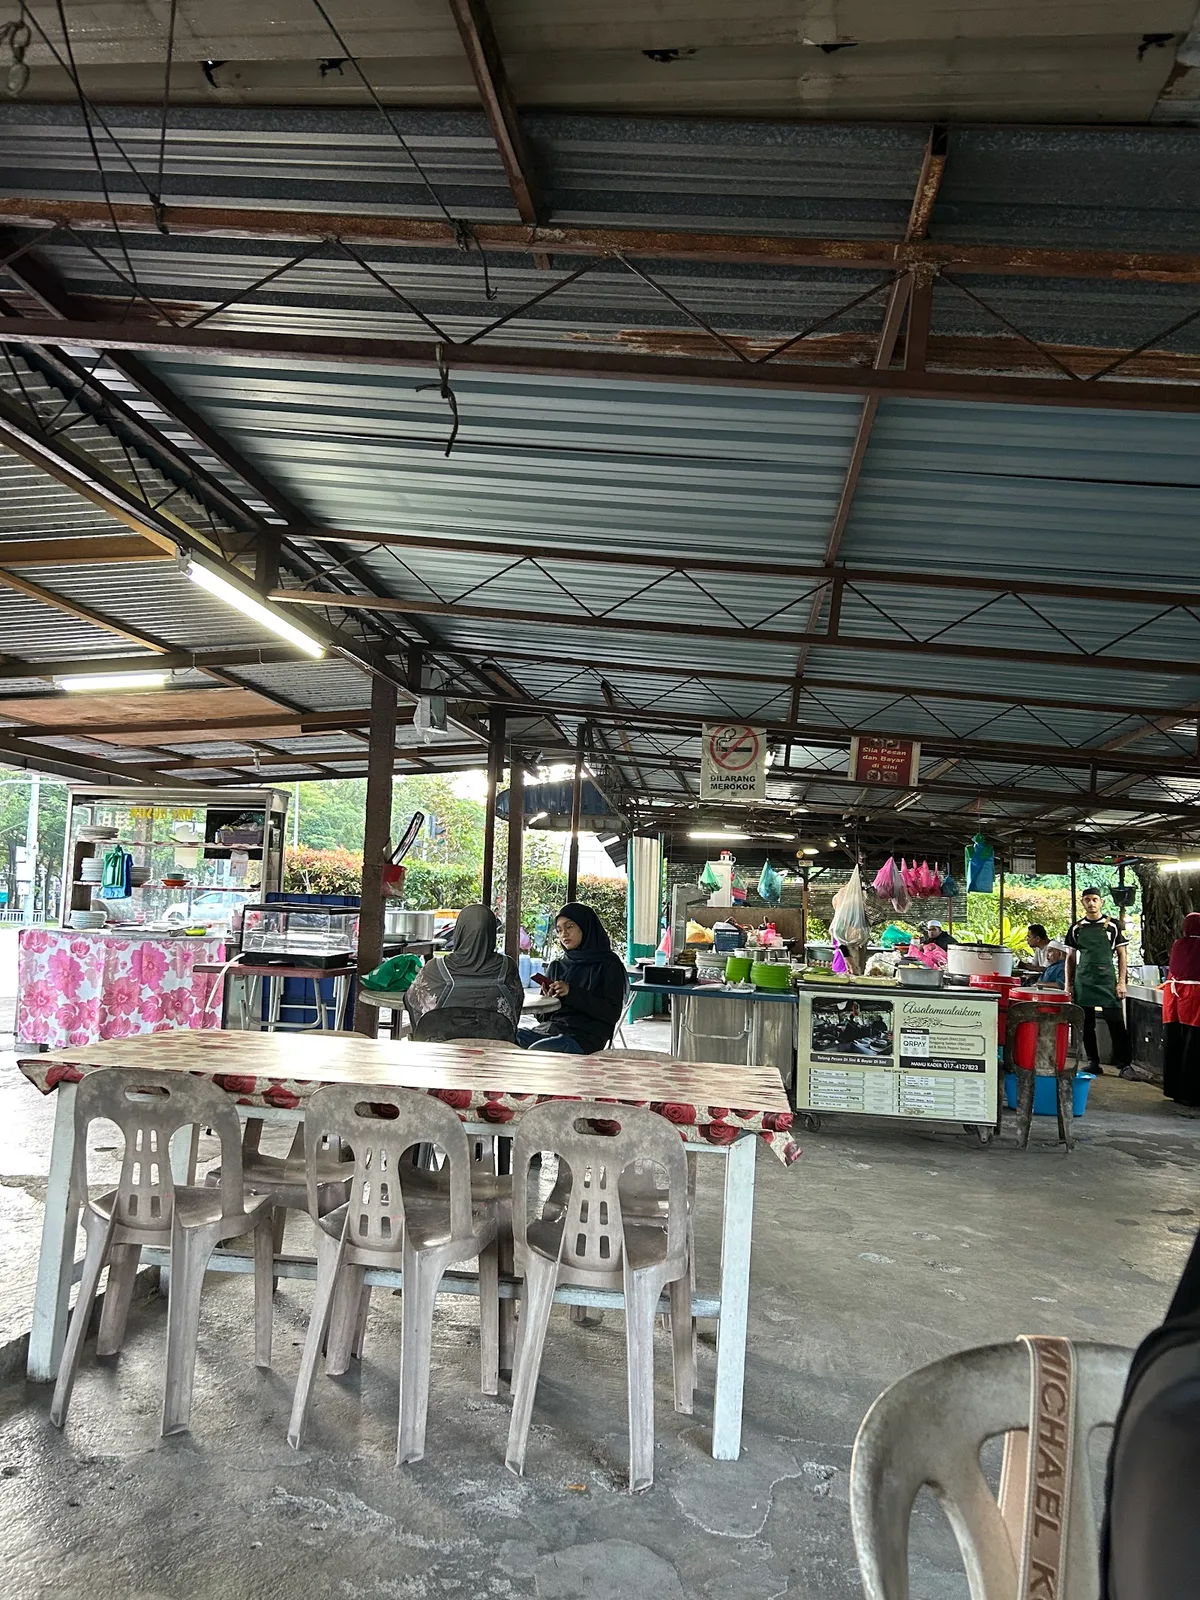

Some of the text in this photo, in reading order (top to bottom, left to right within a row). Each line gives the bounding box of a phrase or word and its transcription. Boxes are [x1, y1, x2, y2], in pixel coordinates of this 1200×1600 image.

[862, 746, 879, 754] Sila
[710, 775, 756, 783] DILARANG
[903, 1001, 981, 1016] Assalamualaikum
[943, 1063, 979, 1071] 017-4127823
[1027, 1337, 1069, 1600] MICHAEL K
